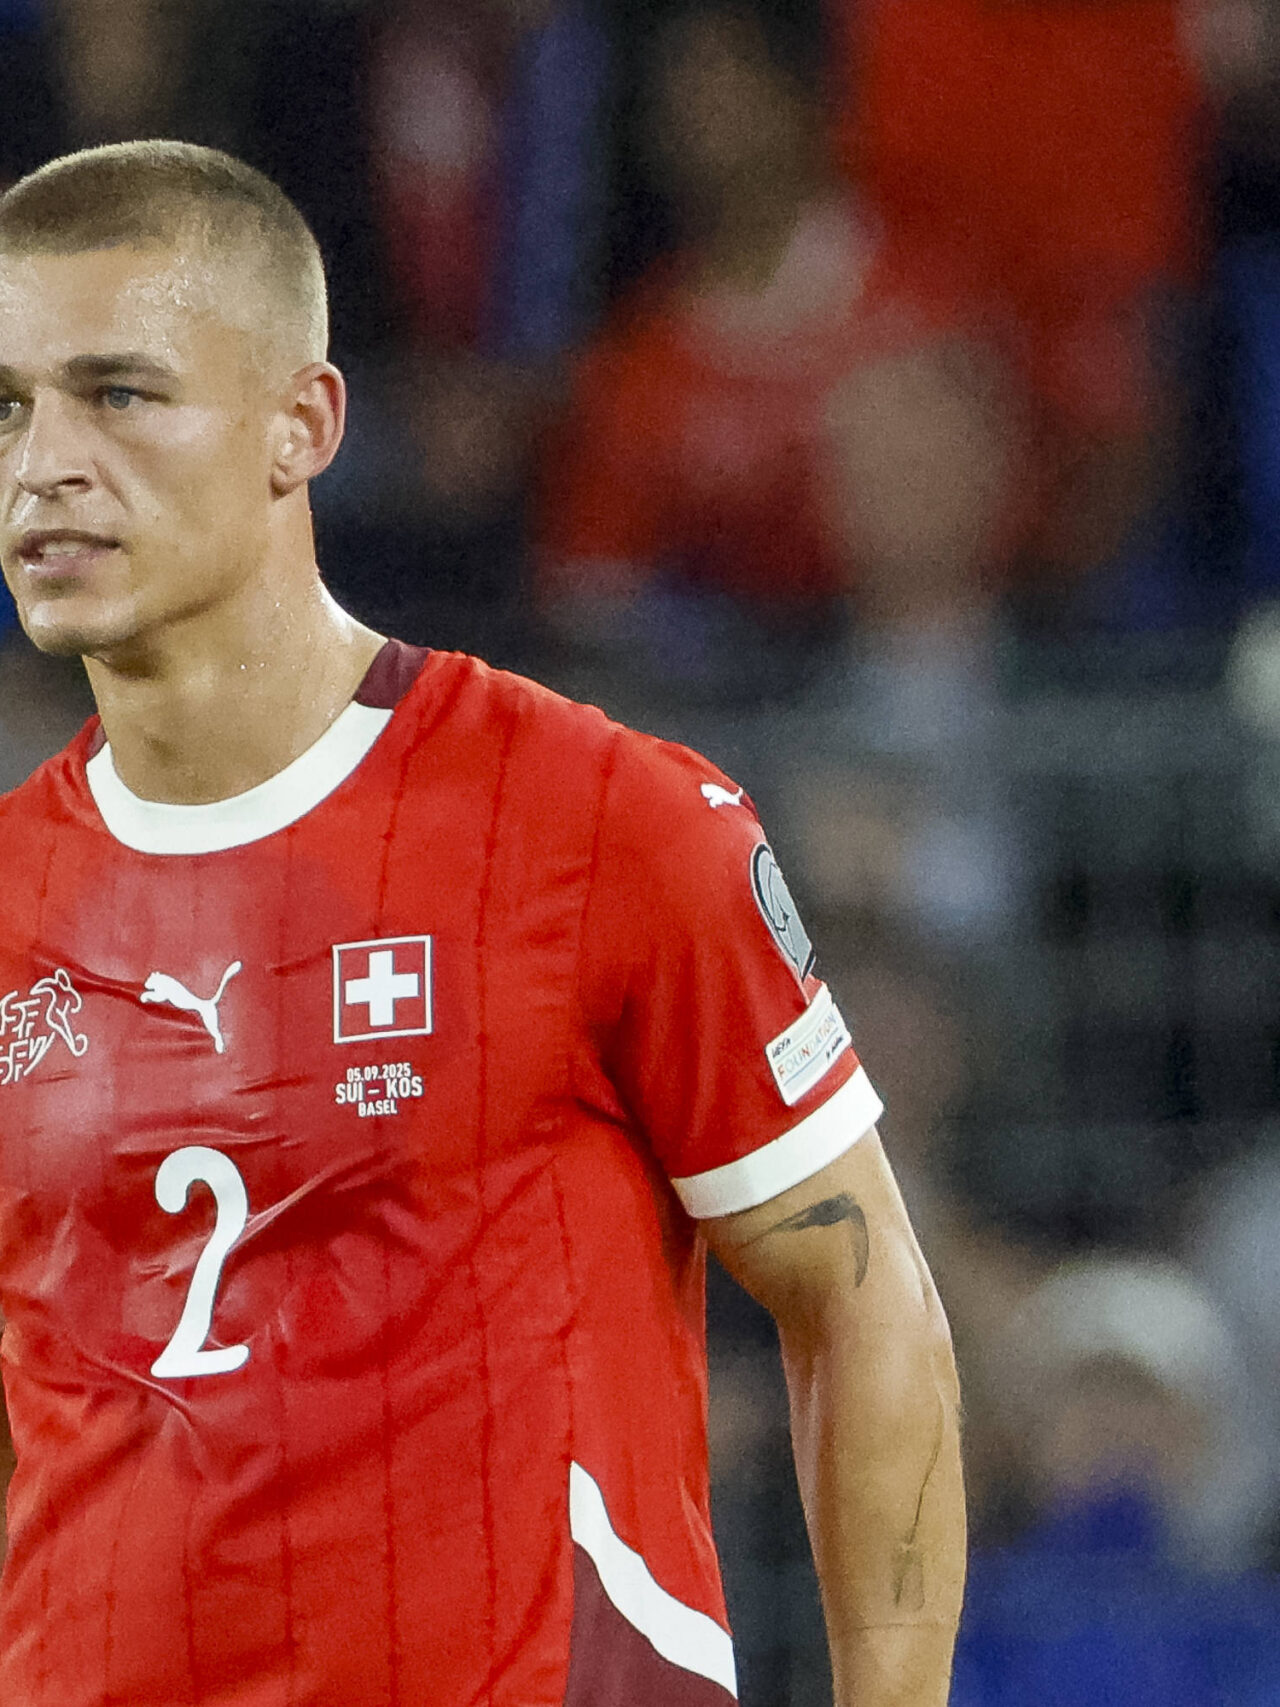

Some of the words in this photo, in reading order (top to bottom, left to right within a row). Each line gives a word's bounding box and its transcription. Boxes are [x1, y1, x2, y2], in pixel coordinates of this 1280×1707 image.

[346, 1062, 412, 1083] 05.09.2025
[335, 1082, 364, 1105] SUI
[386, 1076, 423, 1099] KOS
[358, 1099, 398, 1118] BASEL
[150, 1145, 249, 1378] 2
